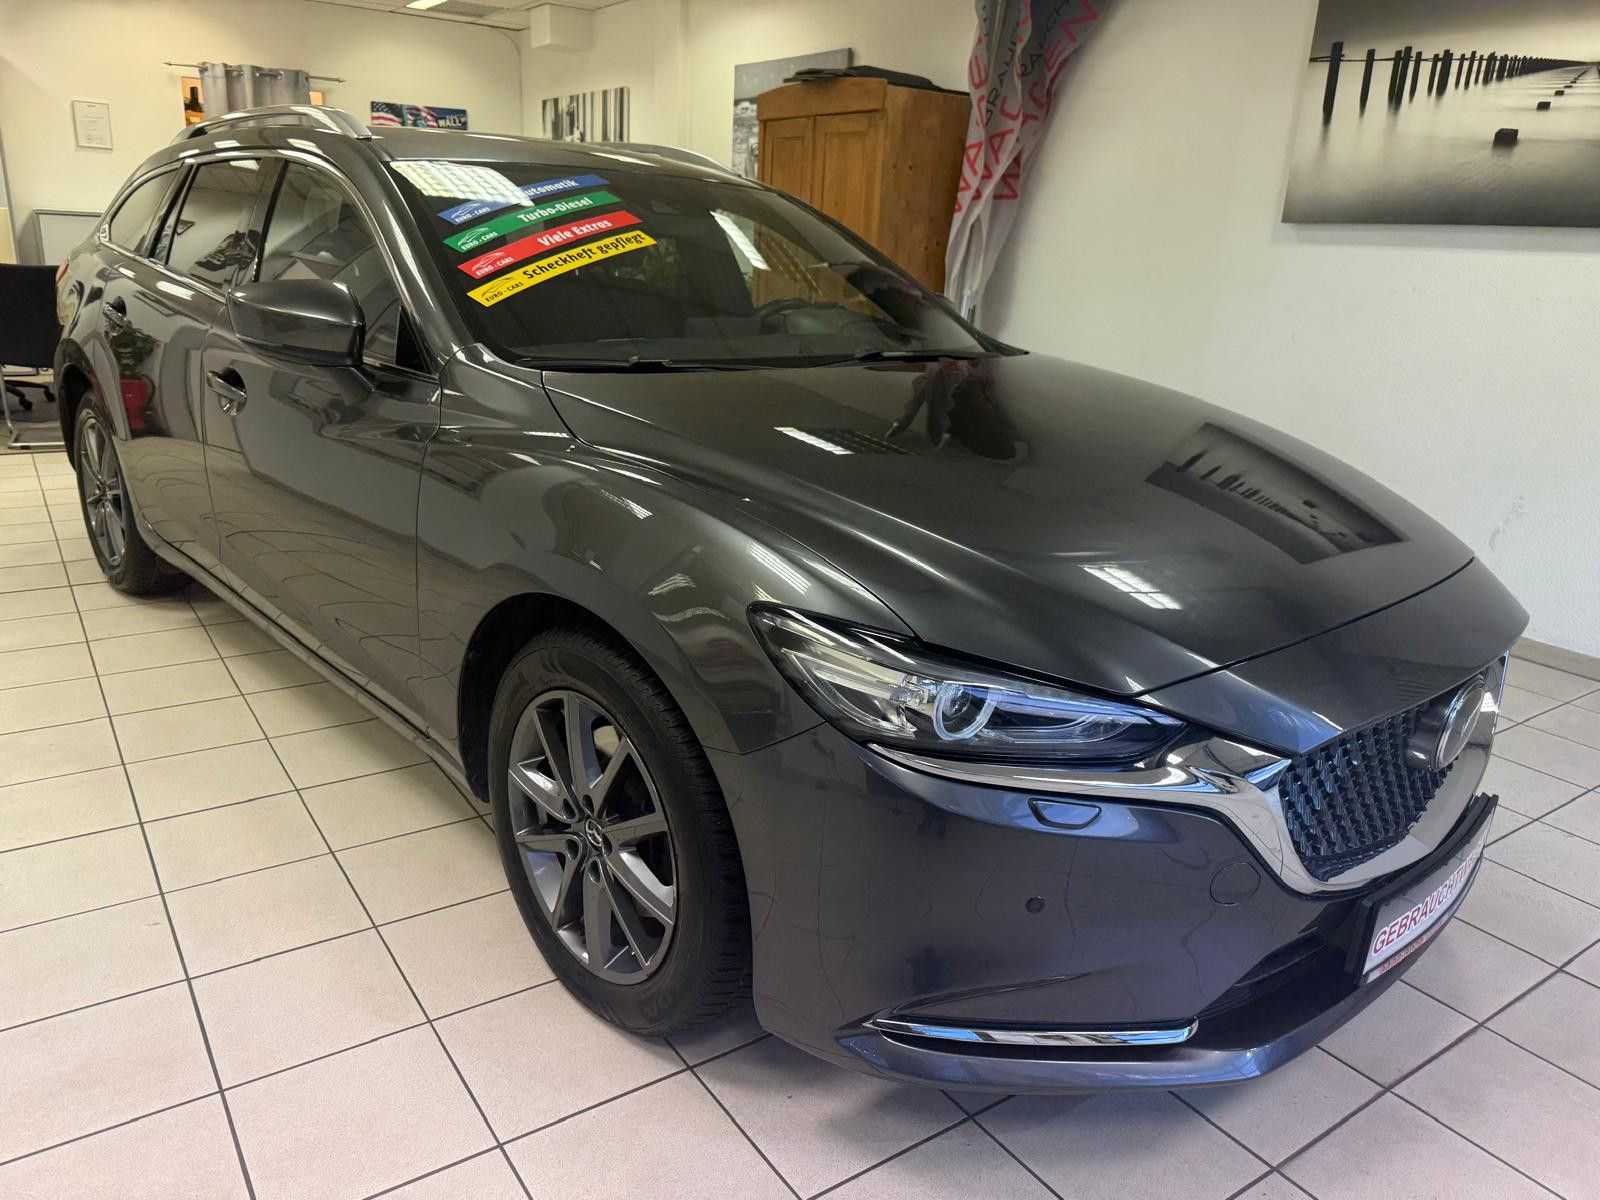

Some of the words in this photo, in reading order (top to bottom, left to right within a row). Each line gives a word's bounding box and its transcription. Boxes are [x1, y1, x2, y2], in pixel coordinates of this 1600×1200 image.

[437, 115, 462, 127] WALL
[474, 206, 491, 215] CARS
[517, 197, 593, 222] Turbo-Diesel
[461, 240, 479, 251] EURO
[482, 231, 498, 240] CARS
[536, 229, 572, 247] Viele
[572, 218, 613, 237] Extras
[475, 265, 494, 276] EURO
[496, 256, 515, 266] CARS
[522, 247, 595, 279] Scheckheft
[597, 233, 646, 254] gepflegt
[485, 292, 504, 303] EURO
[506, 282, 524, 292] CARS
